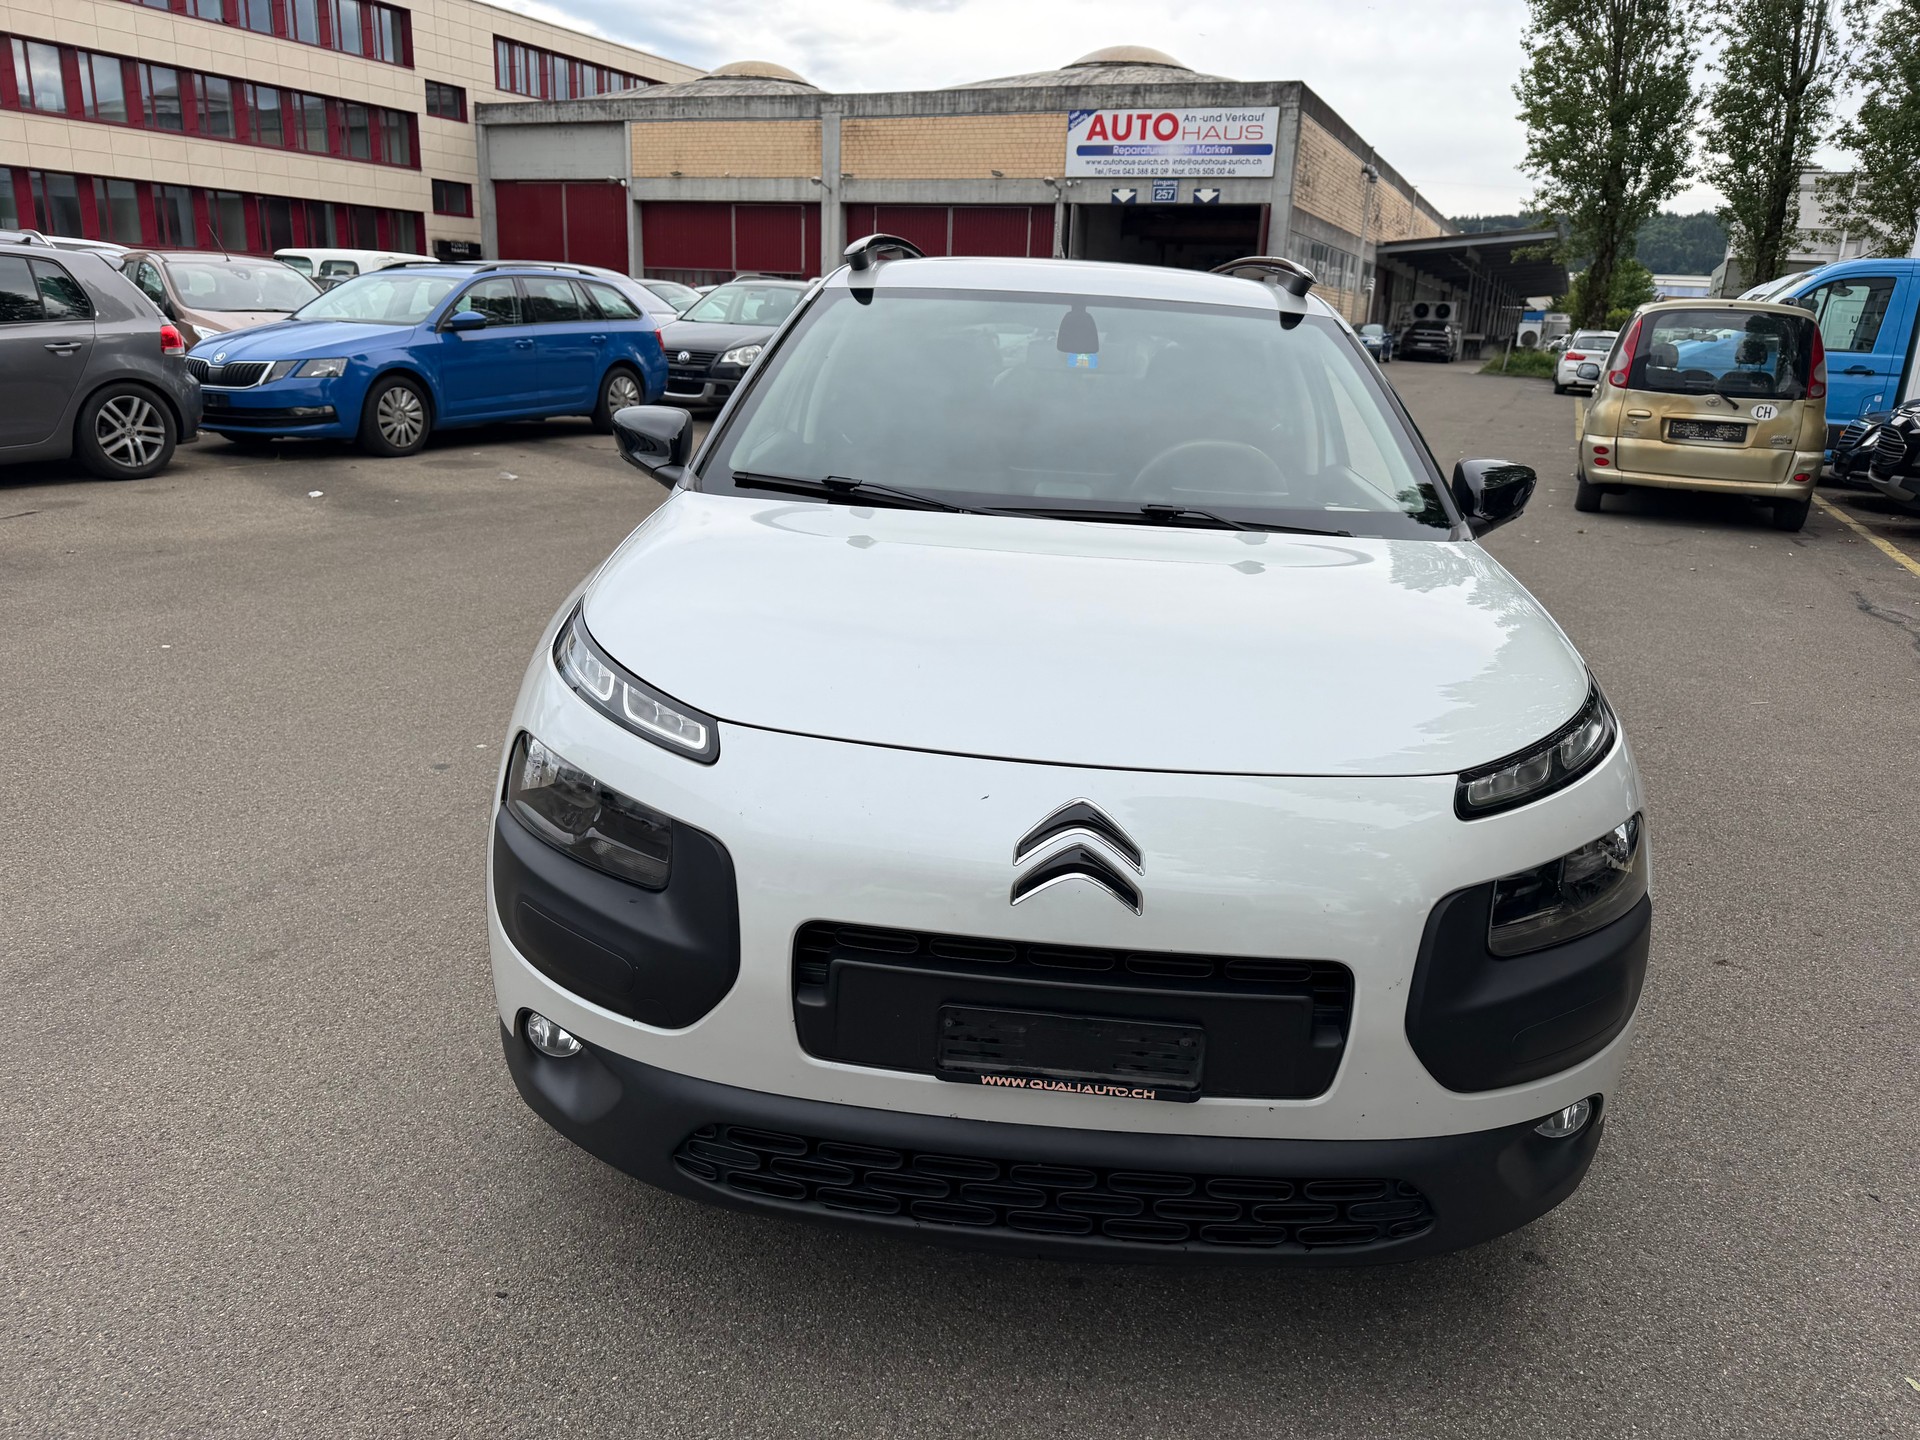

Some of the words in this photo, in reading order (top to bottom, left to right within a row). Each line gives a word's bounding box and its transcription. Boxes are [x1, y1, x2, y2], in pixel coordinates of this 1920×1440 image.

[1183, 114, 1197, 122] An
[1199, 113, 1222, 122] -und
[1225, 112, 1265, 122] Verkauf
[1086, 112, 1179, 141] AUTO
[1182, 124, 1264, 140] HAUS
[1196, 144, 1233, 154] Marken
[1122, 167, 1135, 175] 043
[1216, 167, 1226, 175] 00
[1155, 189, 1174, 199] 257
[1755, 406, 1772, 419] CH
[981, 1075, 1155, 1099] WWW.QUALIAUTO.CH
